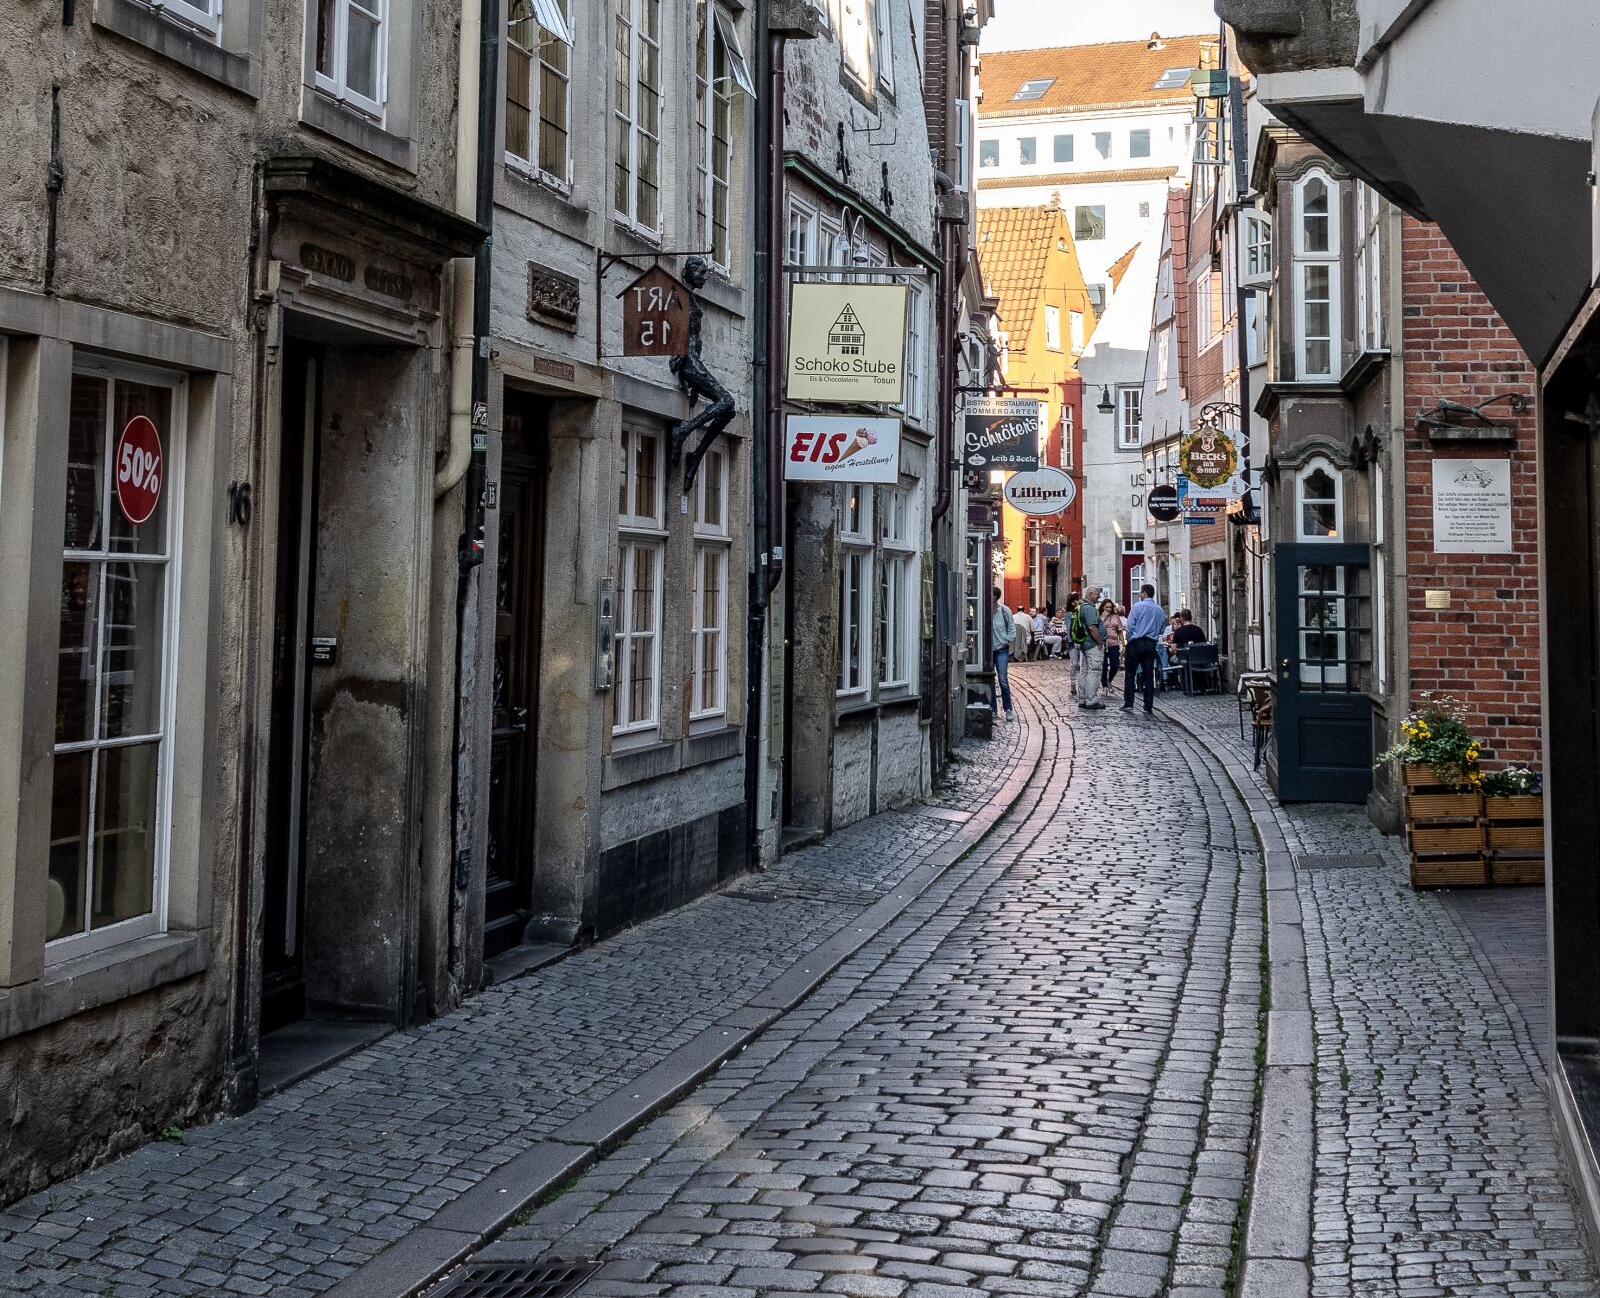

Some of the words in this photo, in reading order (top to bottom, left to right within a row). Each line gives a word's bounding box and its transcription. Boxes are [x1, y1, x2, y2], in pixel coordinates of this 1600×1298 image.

[794, 357, 850, 373] Schoko
[852, 358, 896, 375] Stube
[873, 376, 896, 385] Tosun
[790, 432, 847, 463] EIS
[824, 463, 846, 471] eigene
[847, 454, 893, 469] Herstellung!
[1016, 455, 1037, 463] Seele
[119, 442, 160, 494] 50%
[1011, 487, 1069, 500] Lilliput
[227, 480, 250, 526] 16
